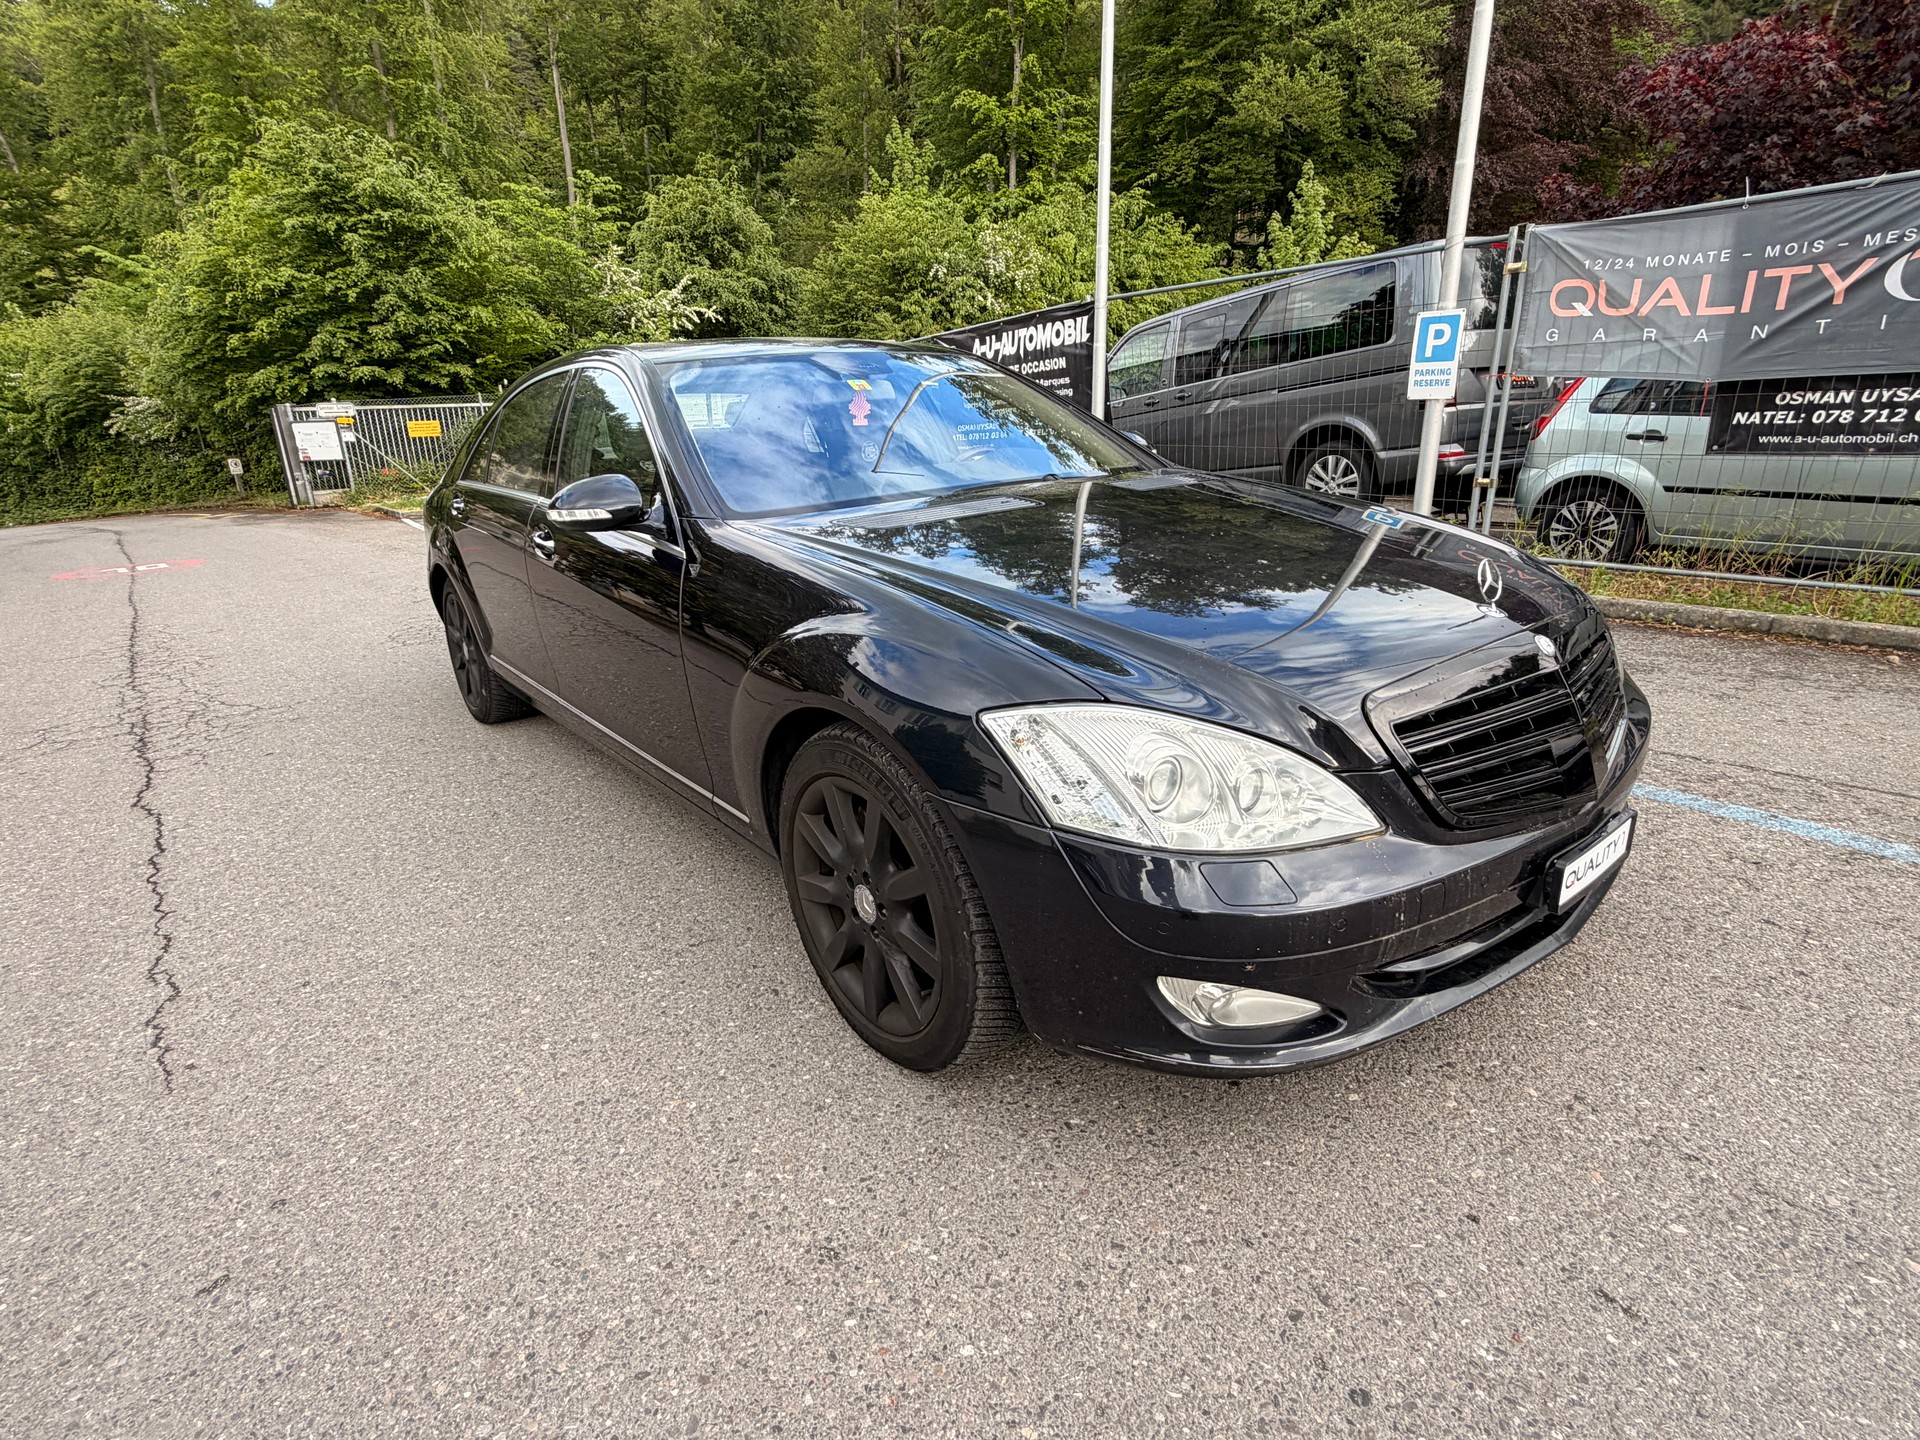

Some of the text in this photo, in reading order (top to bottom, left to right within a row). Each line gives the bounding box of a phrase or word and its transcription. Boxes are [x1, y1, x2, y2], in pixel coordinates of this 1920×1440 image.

[1583, 257, 1635, 271] 12/24
[1645, 249, 1732, 268] MONATE
[1764, 239, 1825, 259] MOIS
[1863, 227, 1918, 247] MES
[1549, 256, 1879, 317] QUALITY
[972, 315, 1091, 363] A-U-AUTOMOBIL
[1424, 322, 1452, 358] P
[1020, 356, 1067, 375] OCCASION
[1414, 367, 1452, 378] PARKING
[1413, 378, 1451, 388] RESERVE
[1775, 389, 1854, 405] OSMAN
[1731, 410, 1806, 425] NATEL:
[1811, 409, 1854, 424] 078
[1859, 407, 1908, 423] 712
[1758, 432, 1919, 445] www.a-u-automobil.ch
[834, 751, 911, 821] MICHELIN
[1565, 833, 1621, 890] QUALITY
